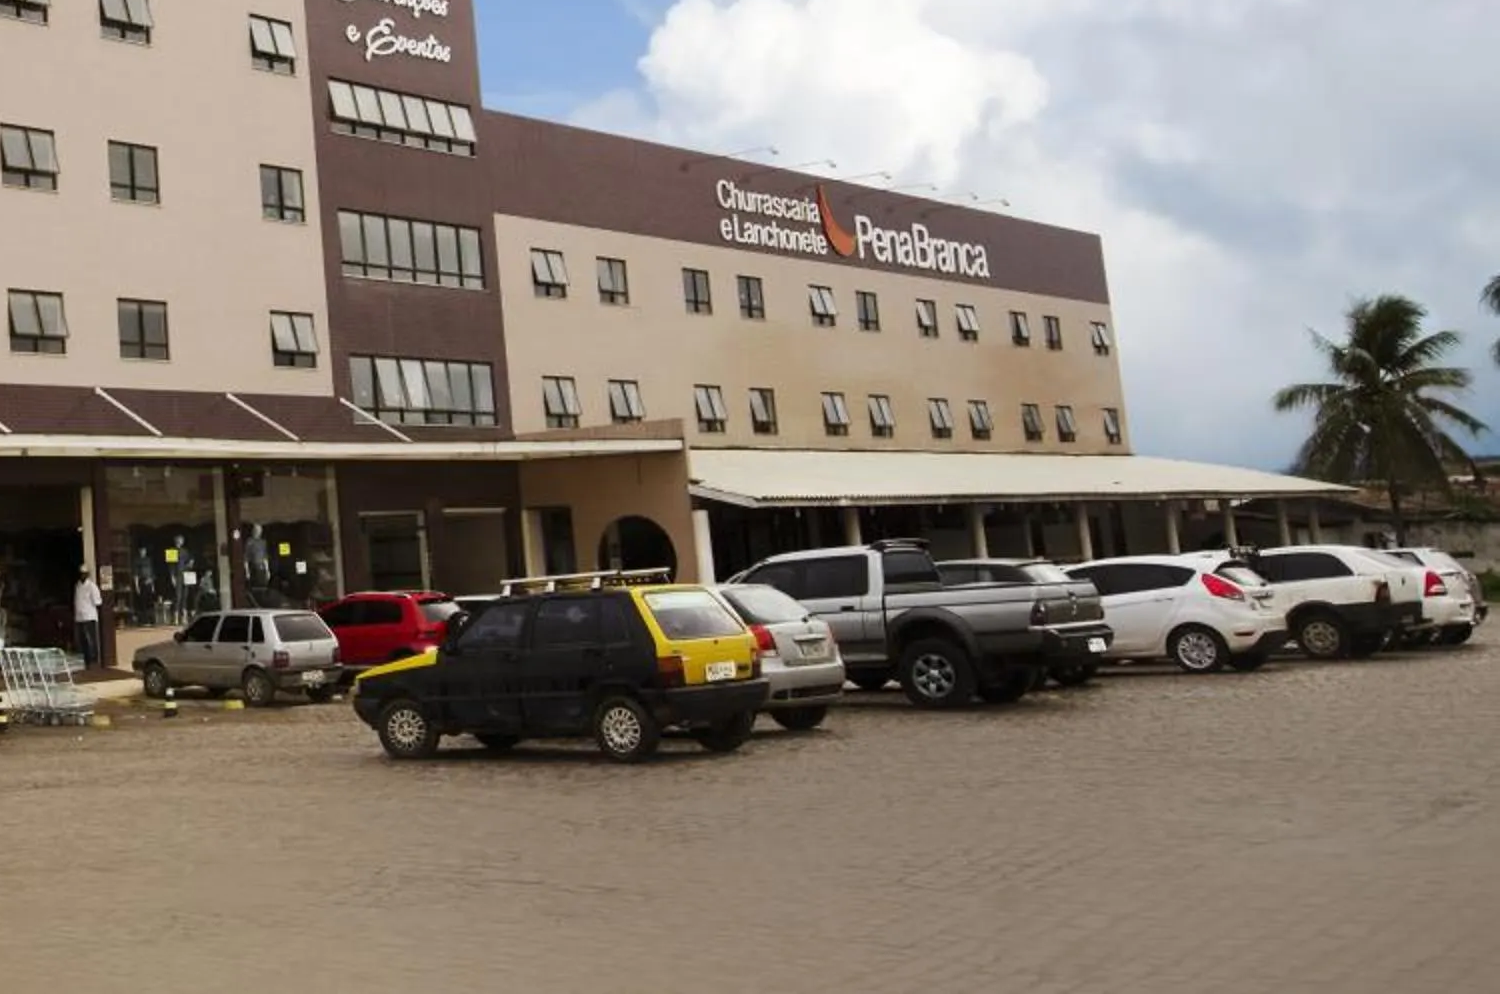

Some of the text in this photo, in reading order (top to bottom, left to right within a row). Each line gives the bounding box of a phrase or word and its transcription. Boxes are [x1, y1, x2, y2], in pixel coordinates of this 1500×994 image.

[346, 18, 451, 61] e Eventos
[716, 179, 821, 224] Churrascaria
[854, 214, 991, 279] PenaBranca
